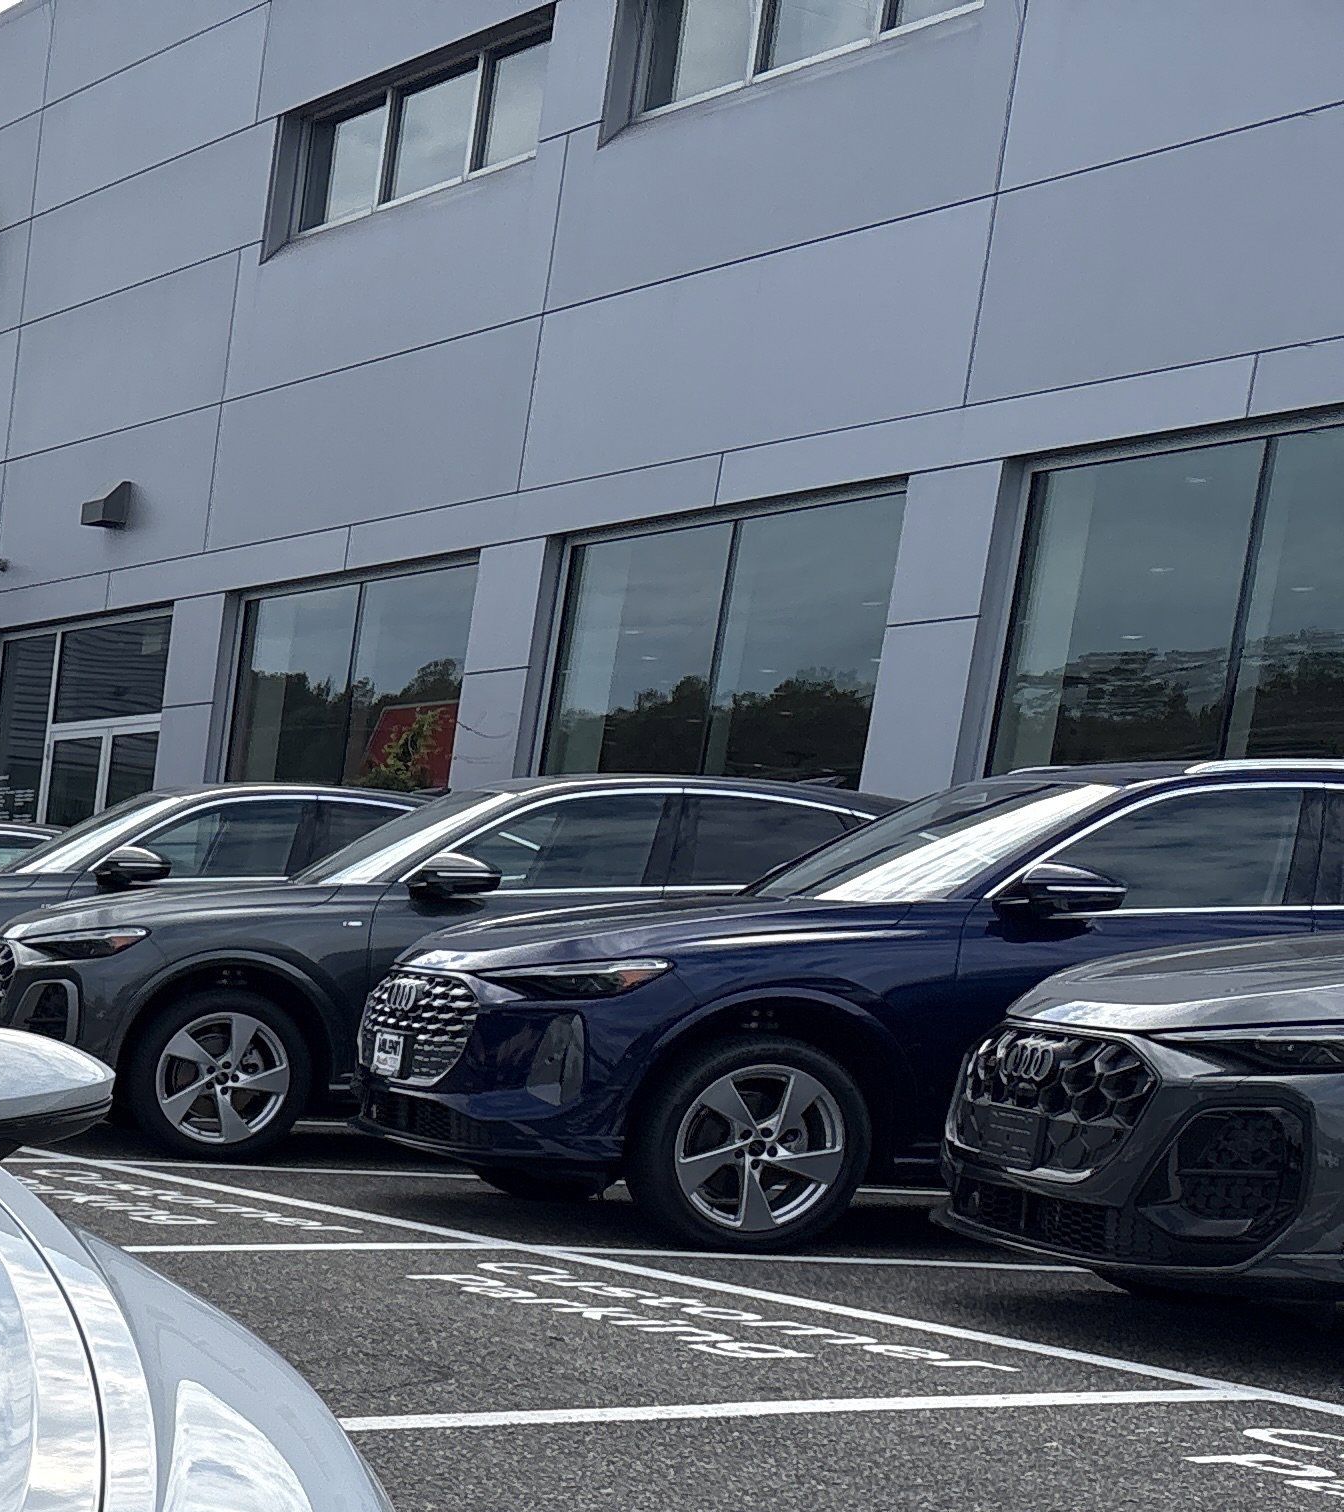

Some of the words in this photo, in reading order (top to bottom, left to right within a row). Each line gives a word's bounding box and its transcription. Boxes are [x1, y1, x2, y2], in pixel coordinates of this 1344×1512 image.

[32, 1169, 364, 1234] Customer
[405, 1274, 815, 1358] Parking
[477, 1262, 1021, 1372] Customer
